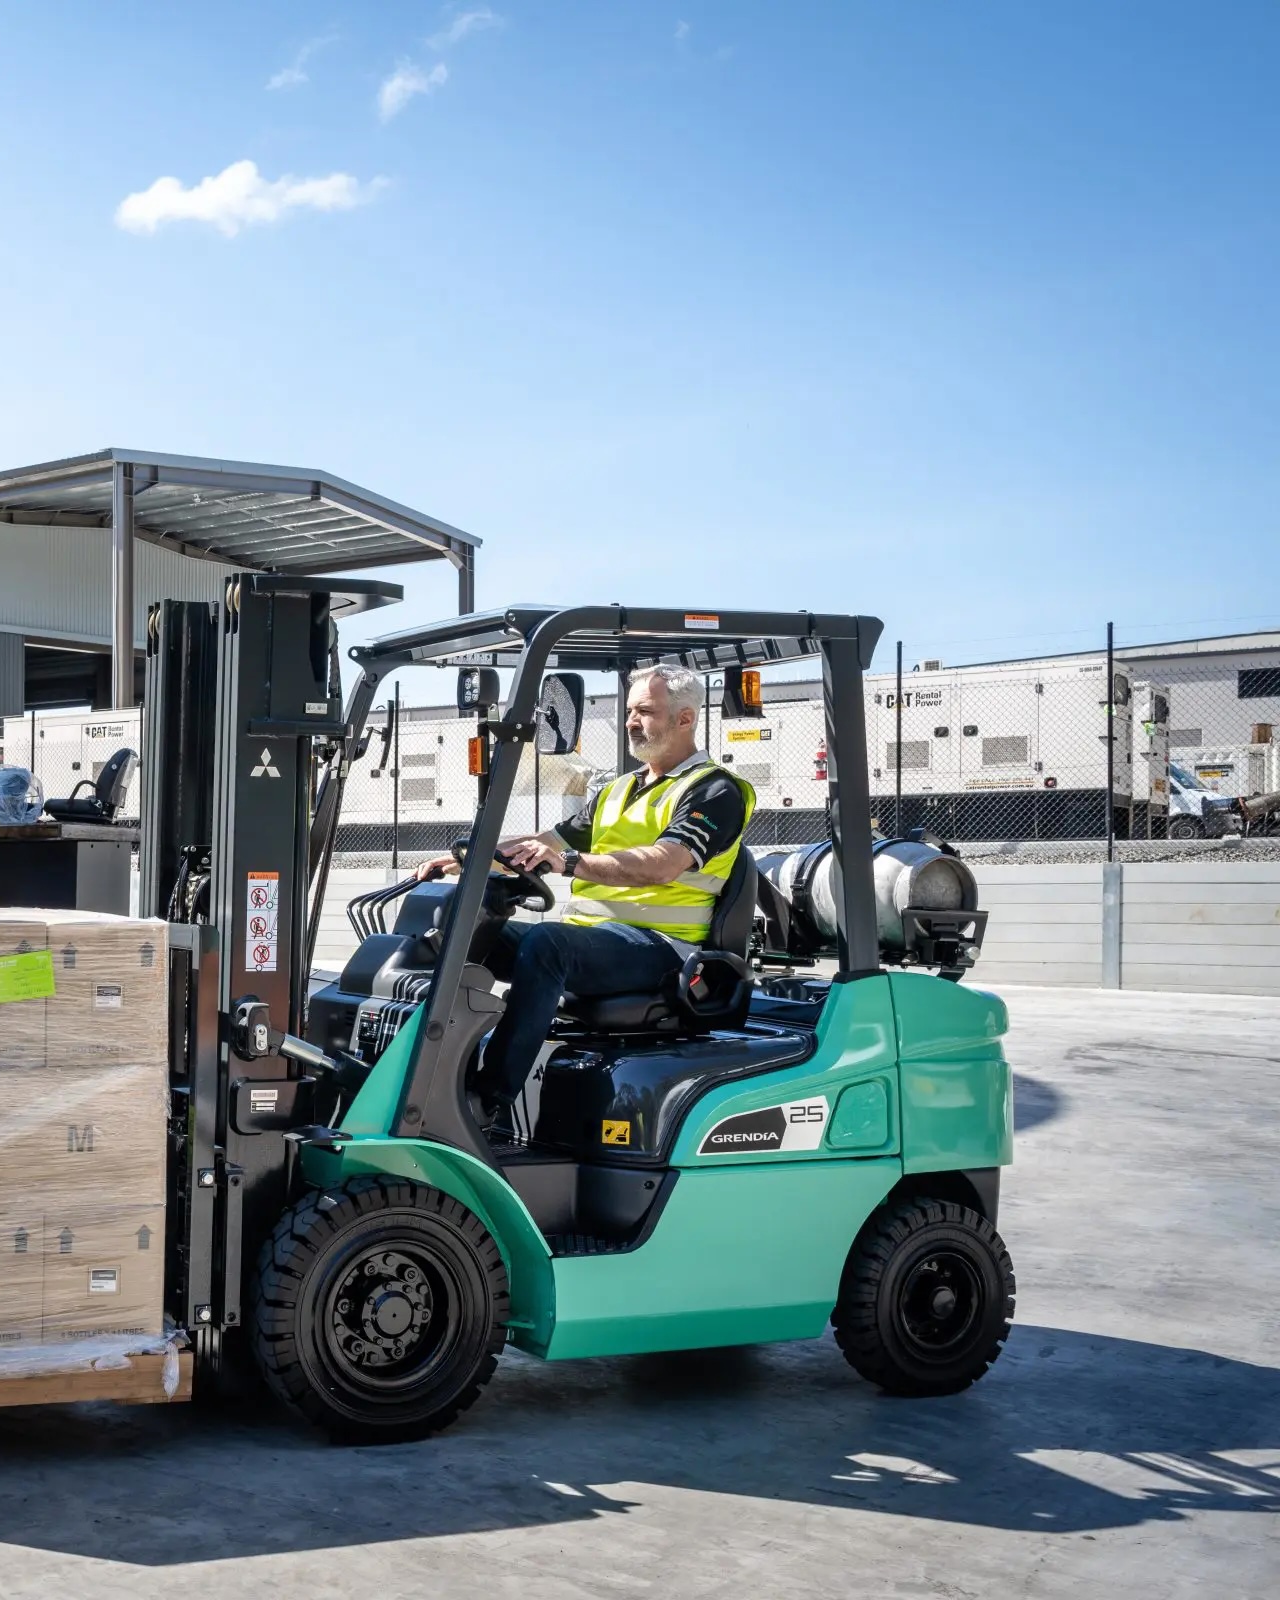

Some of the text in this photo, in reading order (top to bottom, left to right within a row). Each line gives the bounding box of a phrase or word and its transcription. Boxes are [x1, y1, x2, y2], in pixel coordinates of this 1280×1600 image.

[915, 690, 942, 700] Rental
[915, 699, 942, 707] Power
[91, 726, 108, 739] CAT
[789, 1105, 823, 1124] 25
[67, 1124, 94, 1153] M
